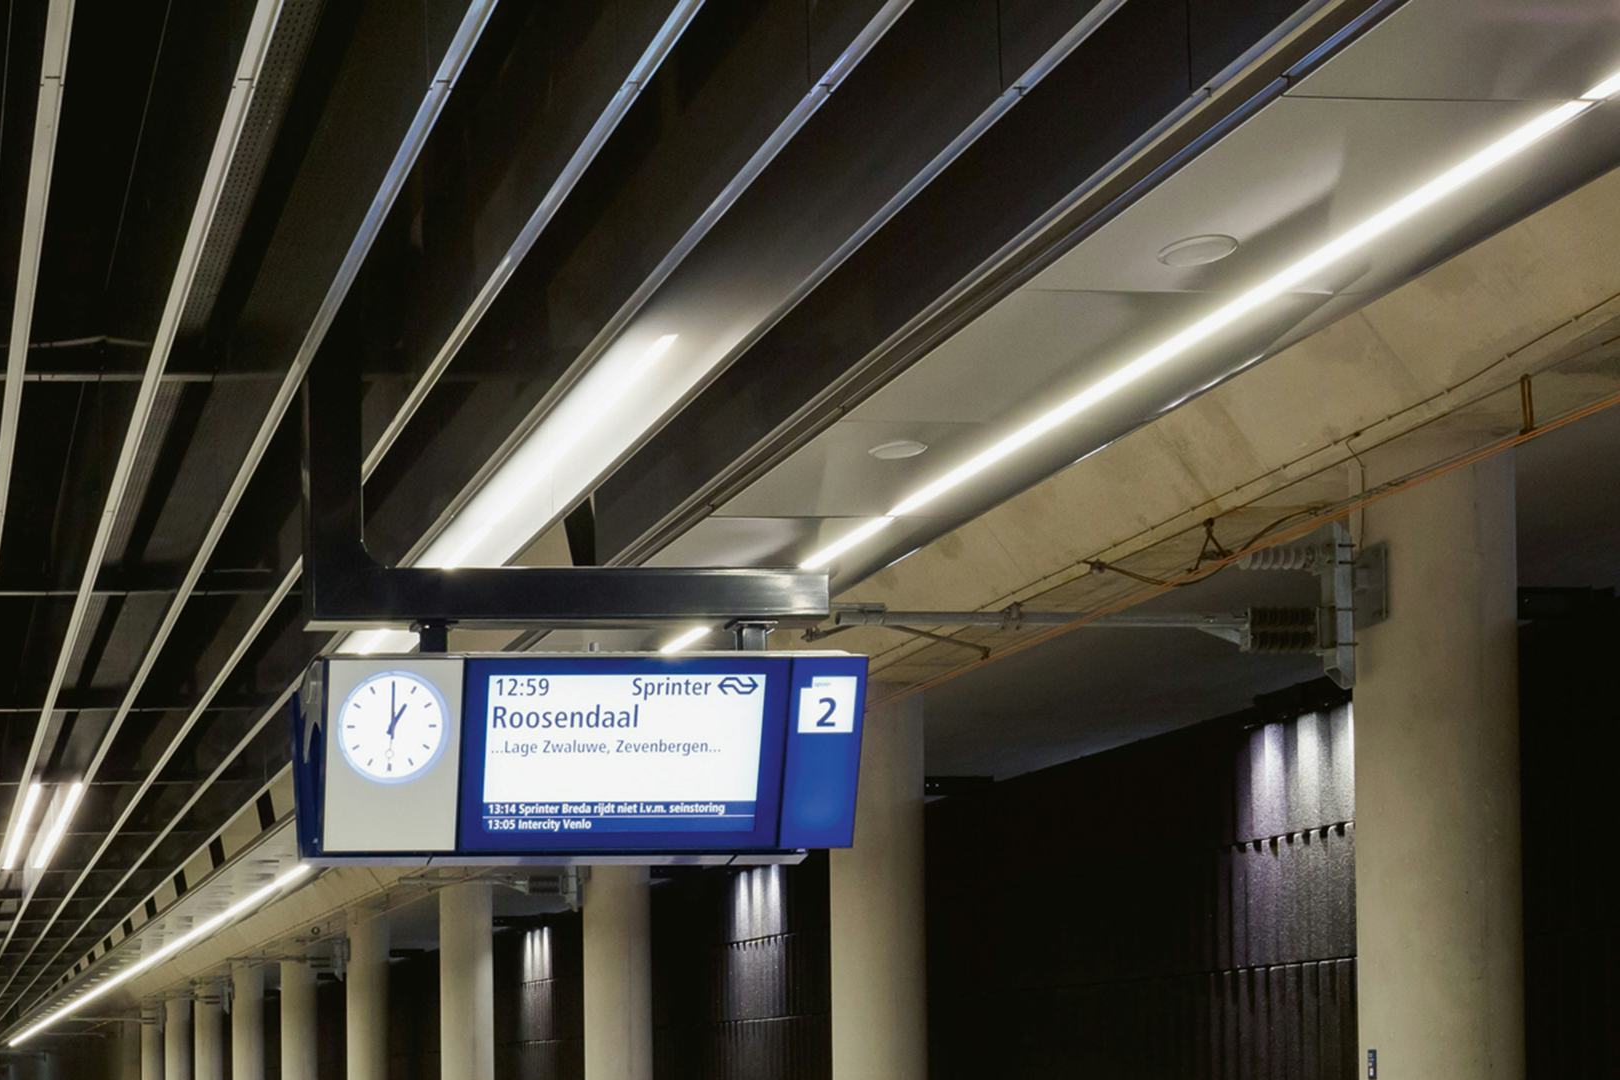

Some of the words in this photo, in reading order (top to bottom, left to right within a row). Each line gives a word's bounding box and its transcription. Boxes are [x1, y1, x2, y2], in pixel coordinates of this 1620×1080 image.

[496, 678, 550, 696] 12:59
[632, 677, 712, 701] Sprinter
[492, 704, 639, 729] Roosendaal
[816, 697, 837, 727] 2
[542, 739, 610, 755] Zwaluwe,
[488, 803, 516, 814] 13:14
[519, 803, 559, 816] Sprinter
[562, 803, 591, 814] Breda
[593, 802, 615, 816] rijdt
[617, 802, 638, 814] niet
[640, 802, 667, 814] i.v.m.
[669, 802, 725, 816] seinstoring
[487, 819, 516, 830] 13:05
[518, 818, 561, 832] Intercity
[563, 819, 592, 830] Venlo
